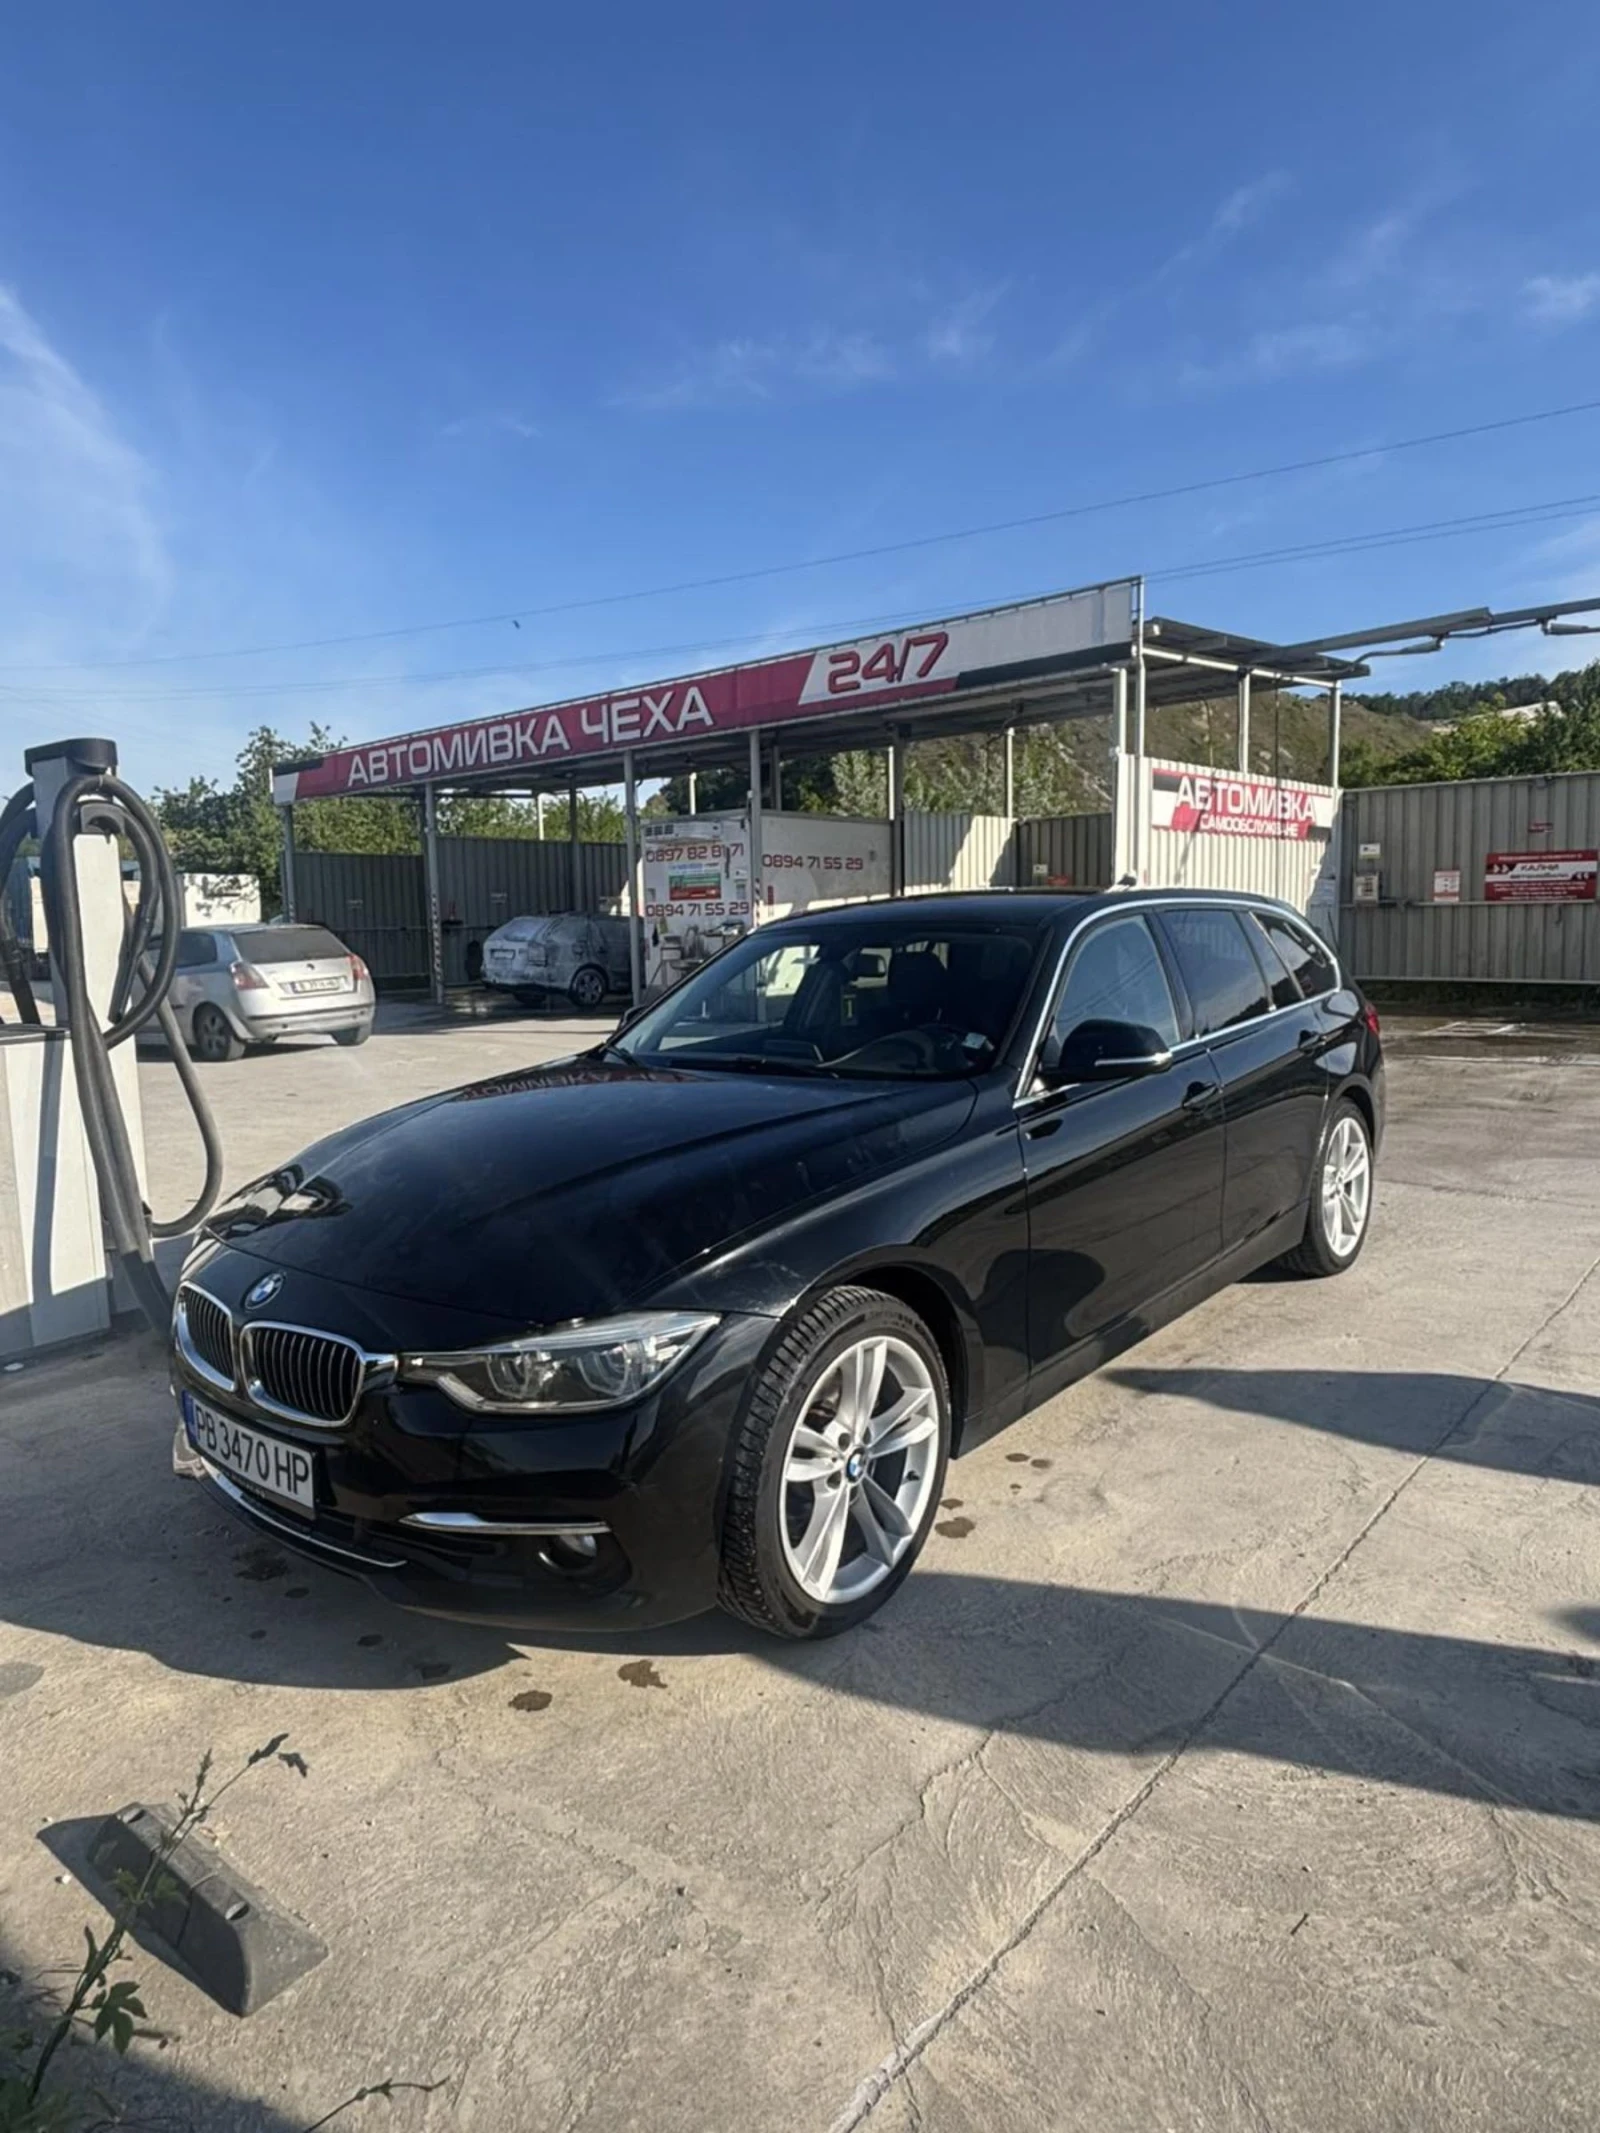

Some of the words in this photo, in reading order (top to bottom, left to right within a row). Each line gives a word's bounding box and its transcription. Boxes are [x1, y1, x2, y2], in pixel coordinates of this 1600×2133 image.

[347, 716, 571, 787] АВТОМИВКА
[581, 686, 714, 743] ЧЕХА
[827, 631, 949, 694] 24/7
[1175, 775, 1317, 824] АВТОМИВКА
[646, 848, 684, 863] 0897
[687, 846, 708, 860] 82
[761, 853, 804, 868] 0894
[807, 855, 821, 869] 71
[823, 856, 842, 870] 55
[845, 856, 864, 870] 29
[645, 903, 684, 917] 0894
[687, 903, 702, 916] 71
[704, 902, 726, 916] 55
[729, 901, 750, 915] 29
[195, 1404, 217, 1451] PB
[219, 1420, 271, 1481] 3470
[274, 1446, 309, 1495] HP
